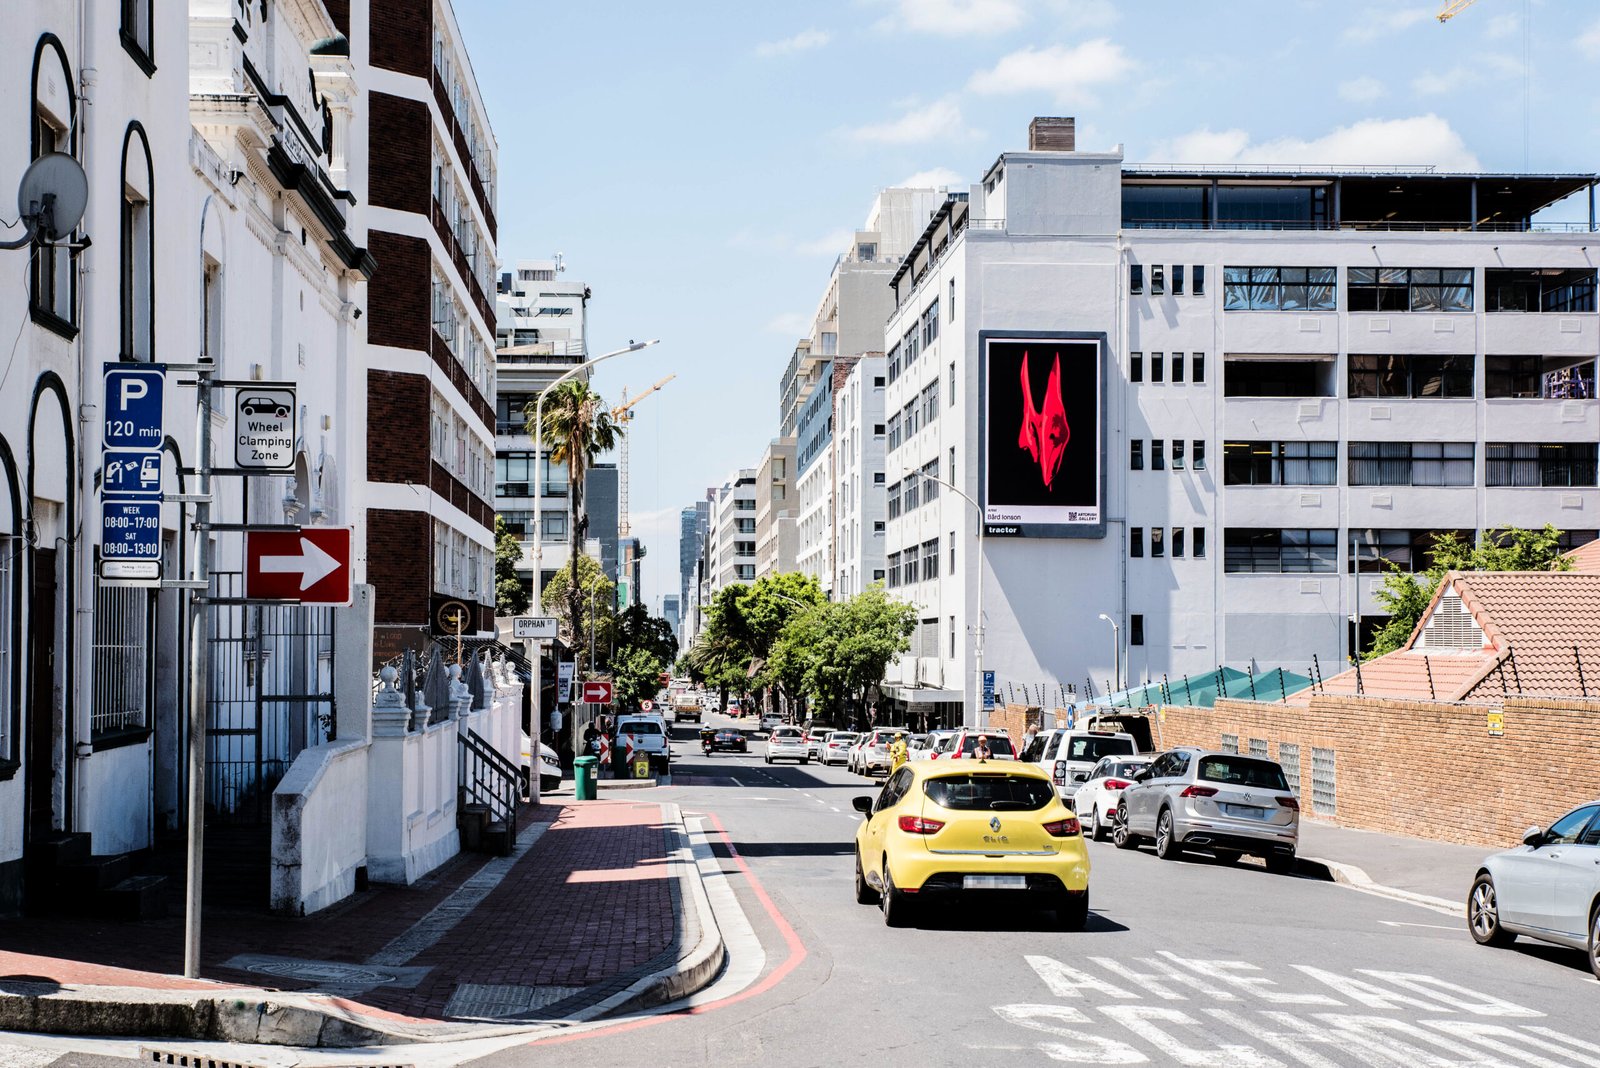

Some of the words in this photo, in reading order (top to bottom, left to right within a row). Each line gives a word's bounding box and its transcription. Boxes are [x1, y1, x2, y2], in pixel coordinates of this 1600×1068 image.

[120, 378, 148, 411] P
[106, 420, 134, 437] 120
[139, 425, 161, 437] min
[247, 421, 284, 432] Wheel
[239, 435, 292, 449] Clamping
[251, 449, 279, 460] Zone
[122, 506, 141, 515] WEEK
[104, 516, 158, 529] 08:00-17:00
[988, 526, 1017, 534] tractor
[124, 532, 137, 541] SAT
[104, 542, 158, 555] 08:00-13:00
[518, 619, 546, 628] ORPHAN
[1023, 951, 1547, 1018] AHEAD
